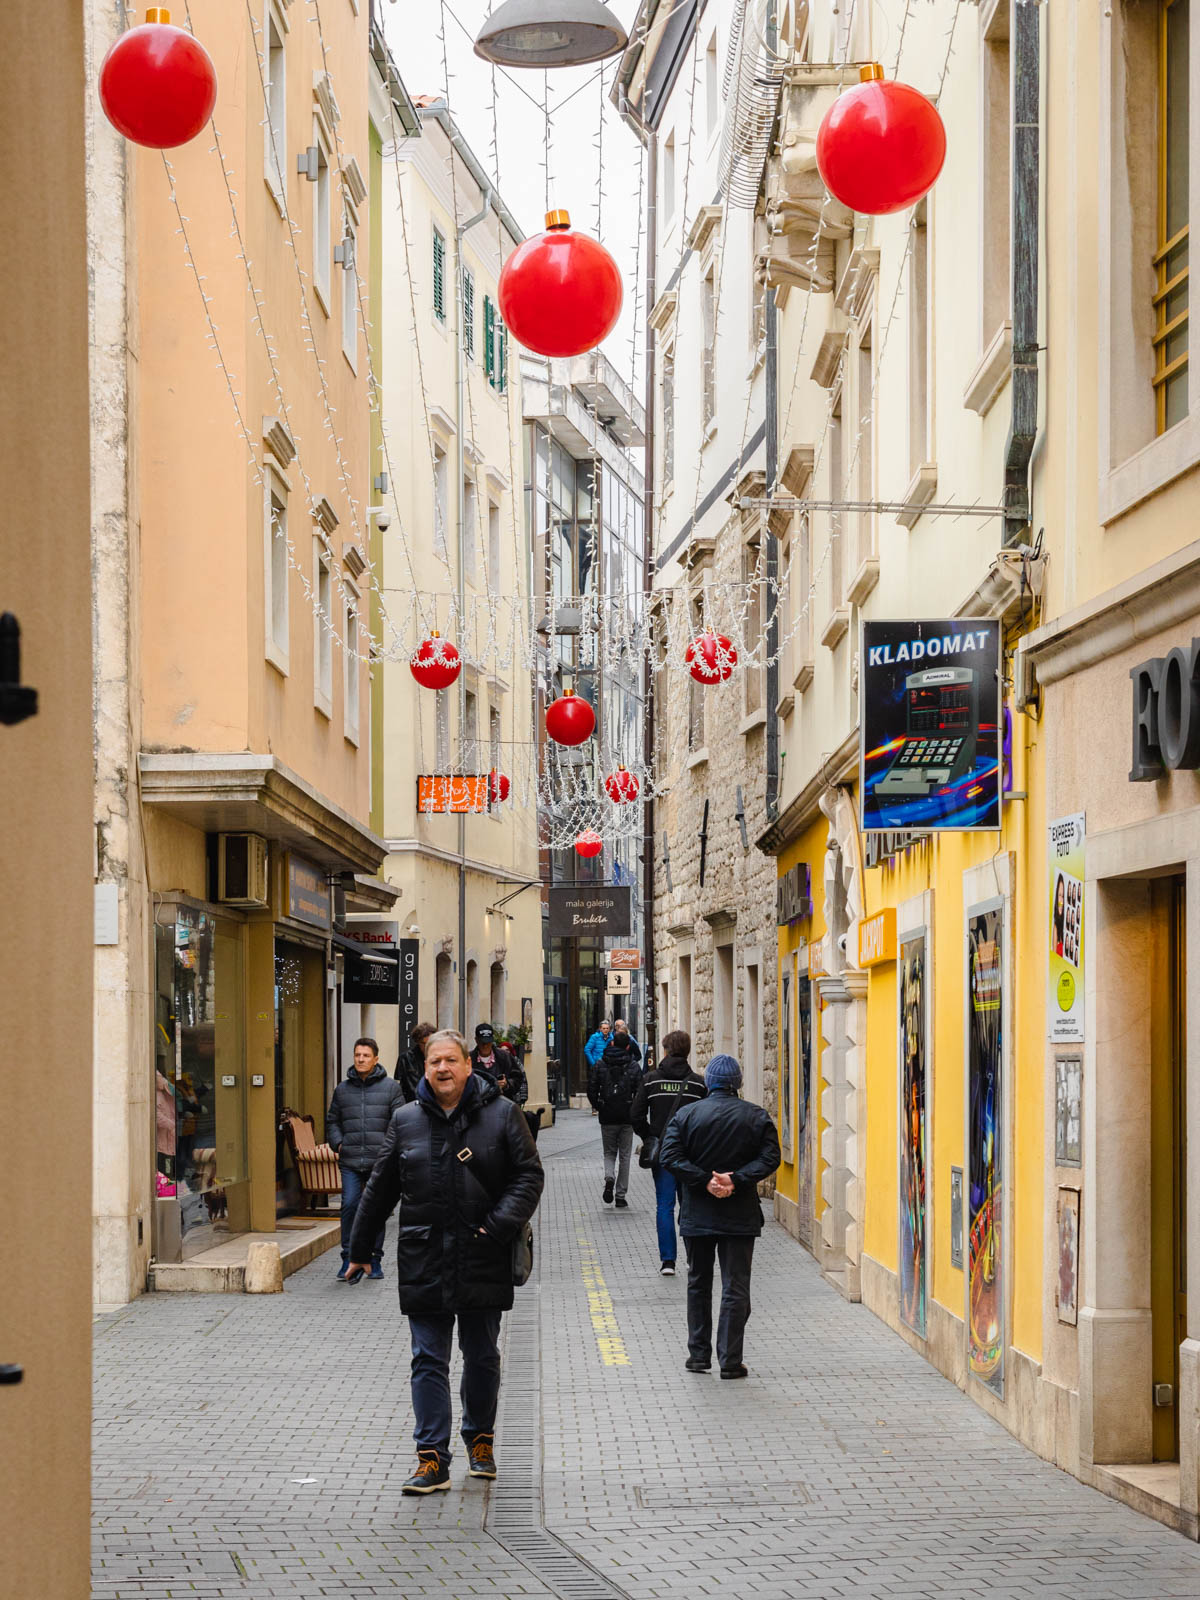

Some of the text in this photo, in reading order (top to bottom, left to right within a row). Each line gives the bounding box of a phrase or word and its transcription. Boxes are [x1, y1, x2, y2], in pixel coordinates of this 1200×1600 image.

[869, 630, 989, 666] KLADOMAT
[925, 672, 951, 681] ADMIRAL
[1128, 636, 1200, 782] FO
[1052, 821, 1074, 841] EXPRESS
[1056, 840, 1070, 858] FOTO
[565, 898, 614, 909] mala galerija
[572, 913, 609, 925] Bruketa
[340, 930, 392, 942] KS Bank
[404, 952, 415, 1048] galeri
